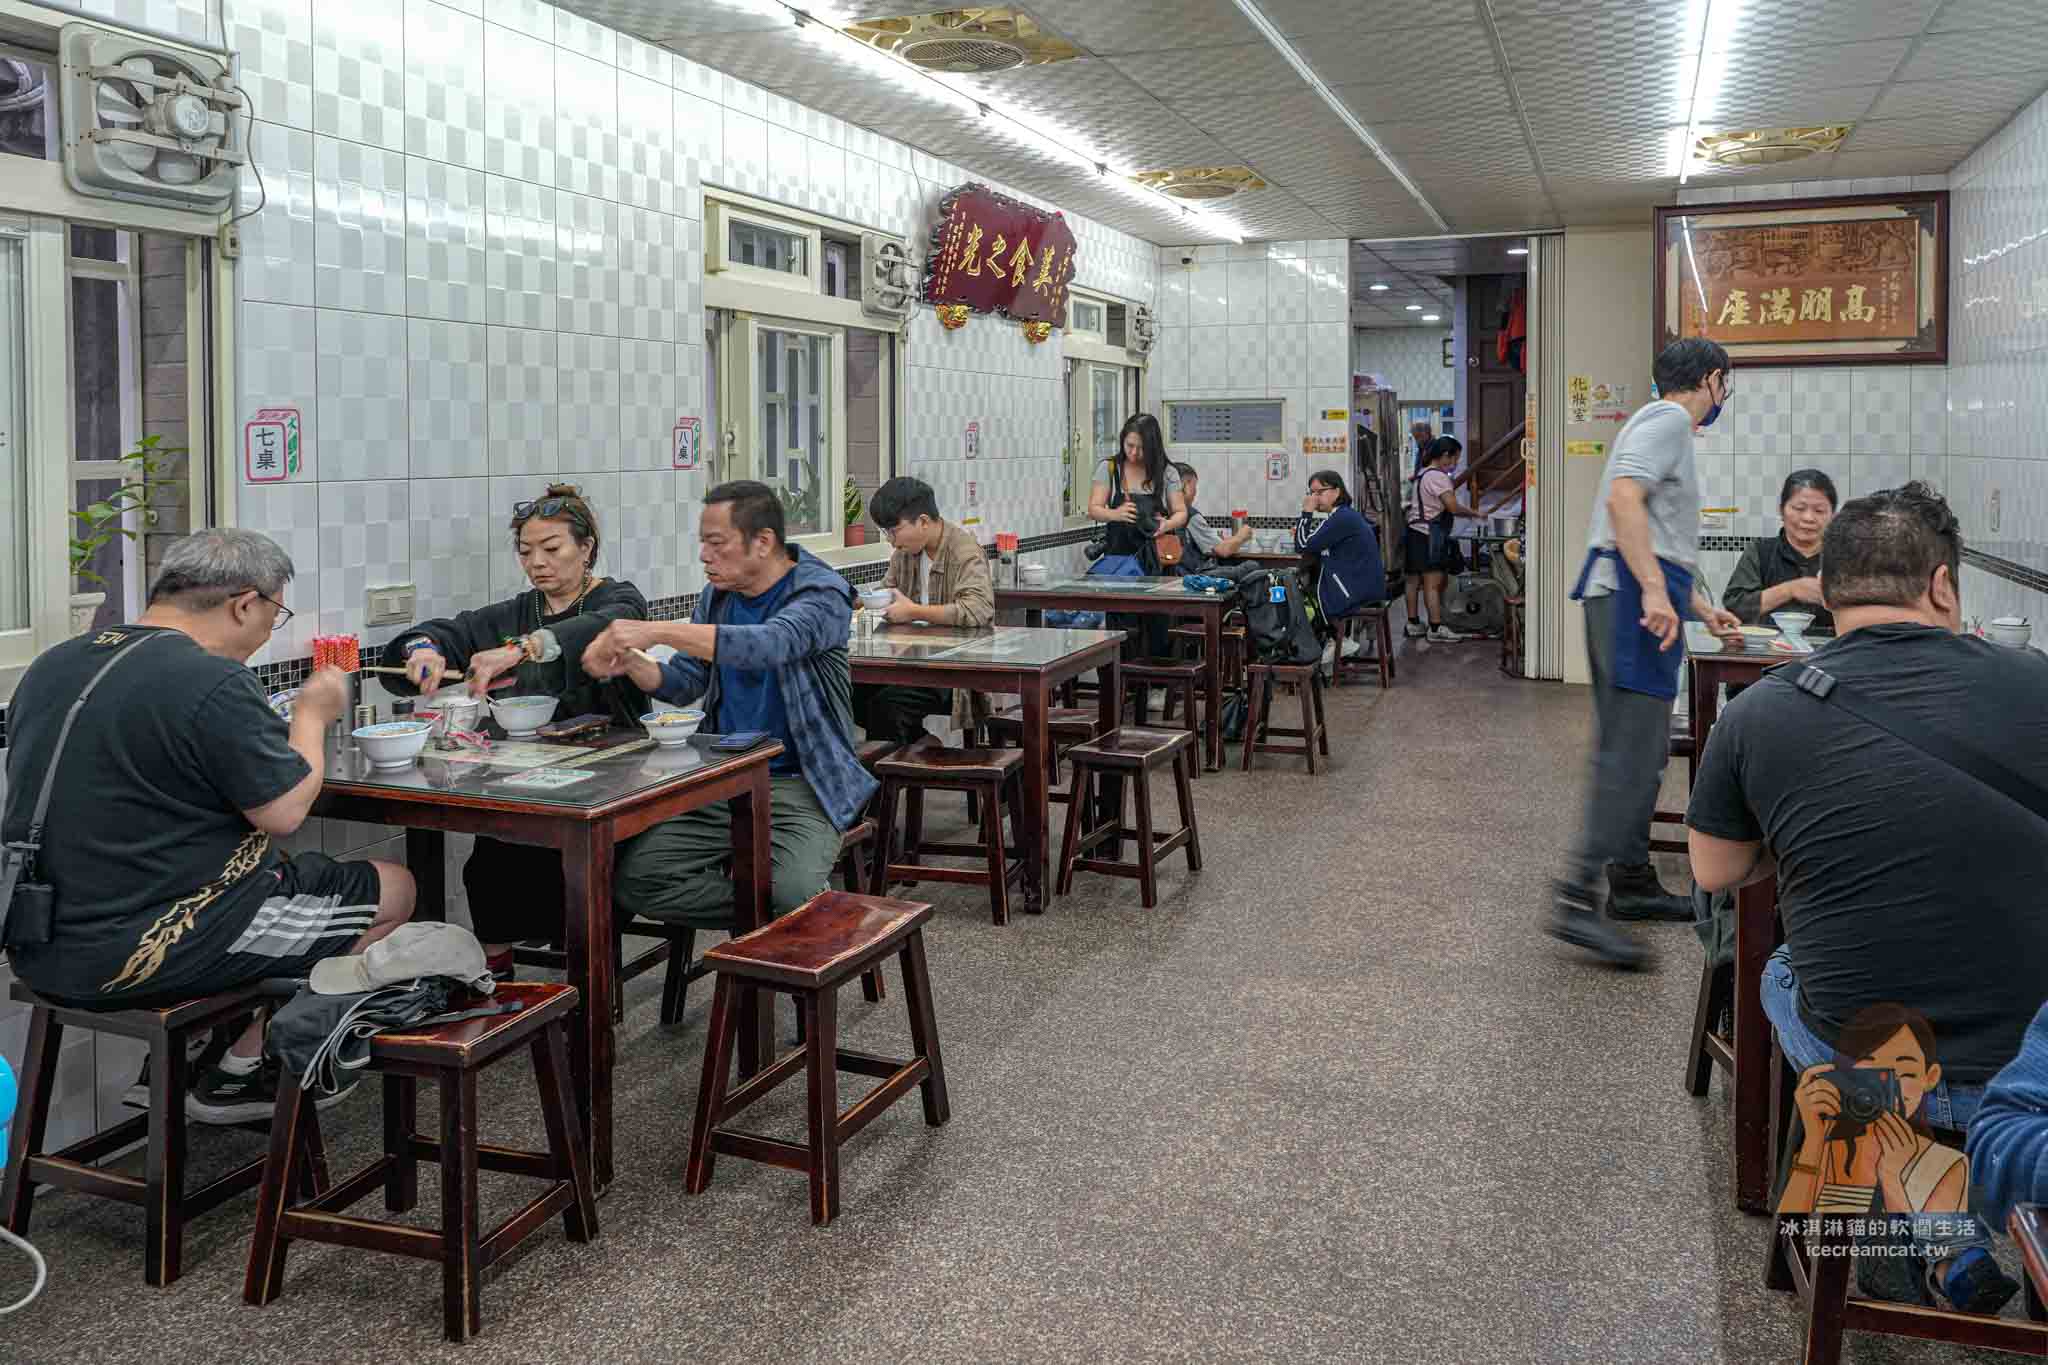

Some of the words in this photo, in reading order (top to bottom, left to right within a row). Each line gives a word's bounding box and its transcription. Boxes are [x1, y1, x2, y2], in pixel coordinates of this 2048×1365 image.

[958, 224, 1054, 296] 美食之光
[1716, 284, 1877, 326] 高朋滿座
[255, 427, 277, 470] 七桌
[678, 431, 689, 460] 八桌
